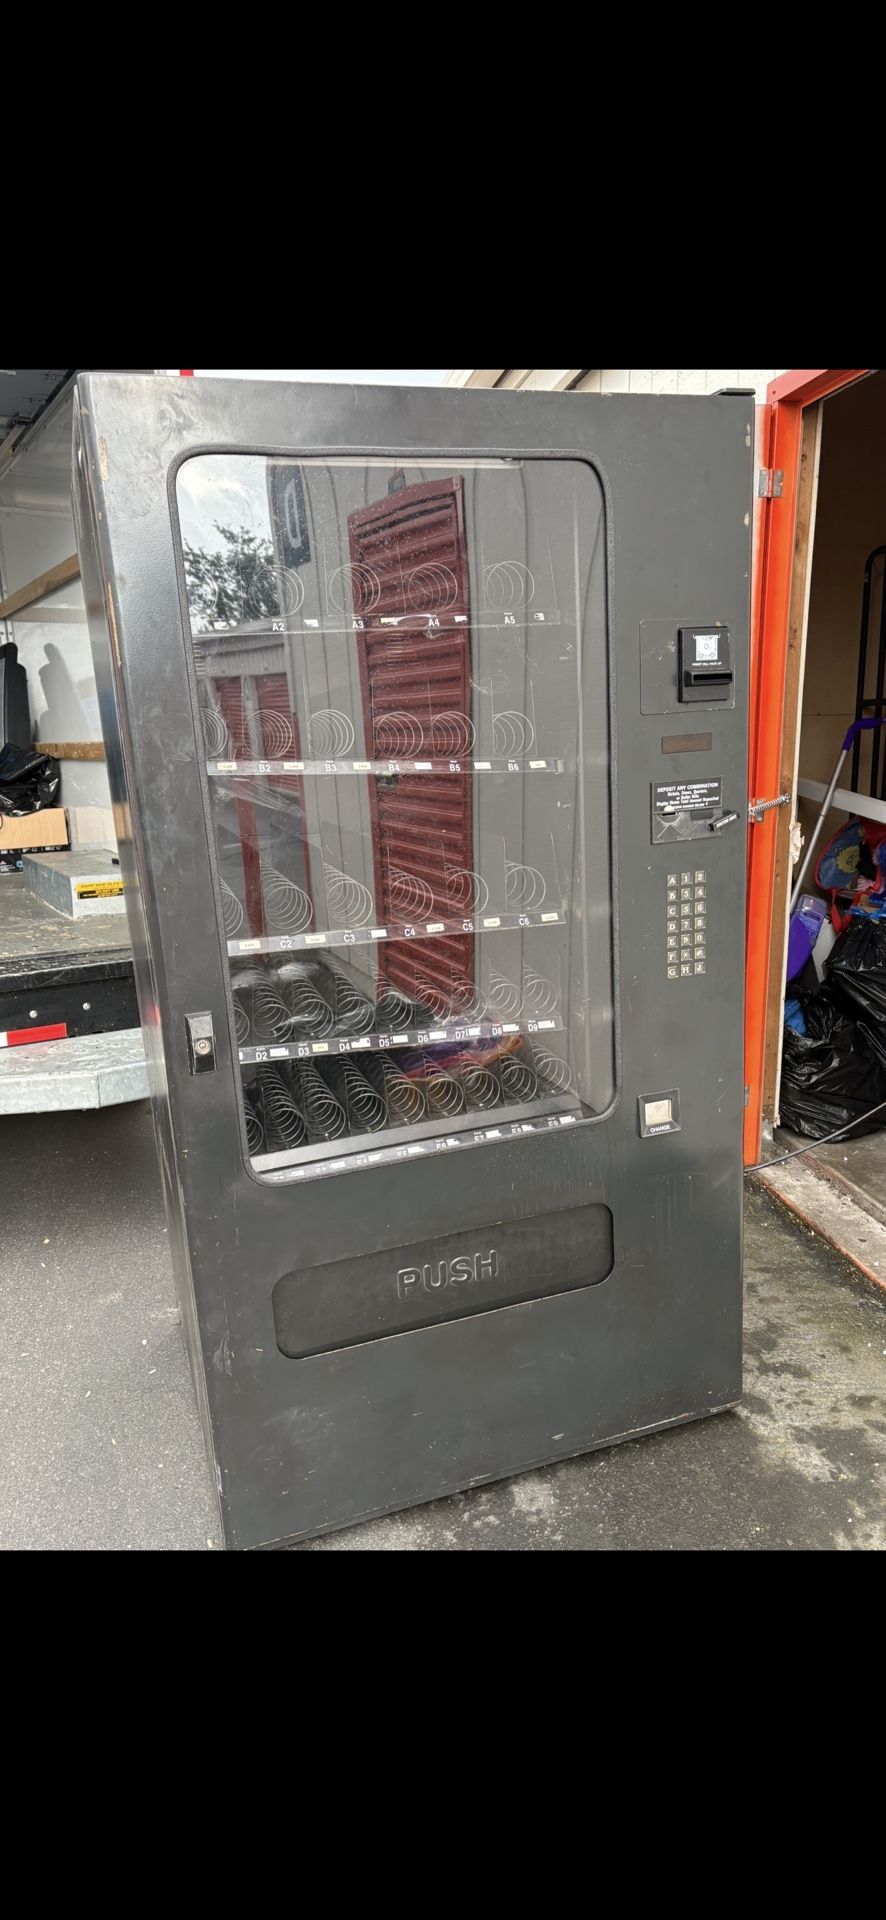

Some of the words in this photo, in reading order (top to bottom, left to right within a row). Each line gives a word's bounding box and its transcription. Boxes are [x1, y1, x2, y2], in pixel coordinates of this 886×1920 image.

[352, 620, 364, 629] A3
[428, 618, 440, 627] A4
[504, 616, 516, 624] A5
[272, 622, 285, 631] A2
[259, 764, 271, 773] B2
[325, 764, 337, 772] B3
[388, 764, 400, 772] B4
[449, 764, 461, 772] B5
[508, 763, 519, 771] B6
[687, 782, 719, 790] COMBINATION
[462, 922, 474, 931] C5
[518, 918, 530, 926] C6
[404, 928, 416, 937] C4
[343, 933, 355, 943] C3
[280, 939, 292, 949] C2
[492, 1027, 503, 1036] D8
[528, 1024, 538, 1032] D9
[379, 1038, 390, 1047] D5
[417, 1034, 429, 1043] D6
[339, 1042, 351, 1051] D4
[255, 1051, 267, 1061] D2
[298, 1047, 310, 1056] D3
[650, 1124, 671, 1133] CHANGE
[396, 1249, 499, 1300] PUSH
